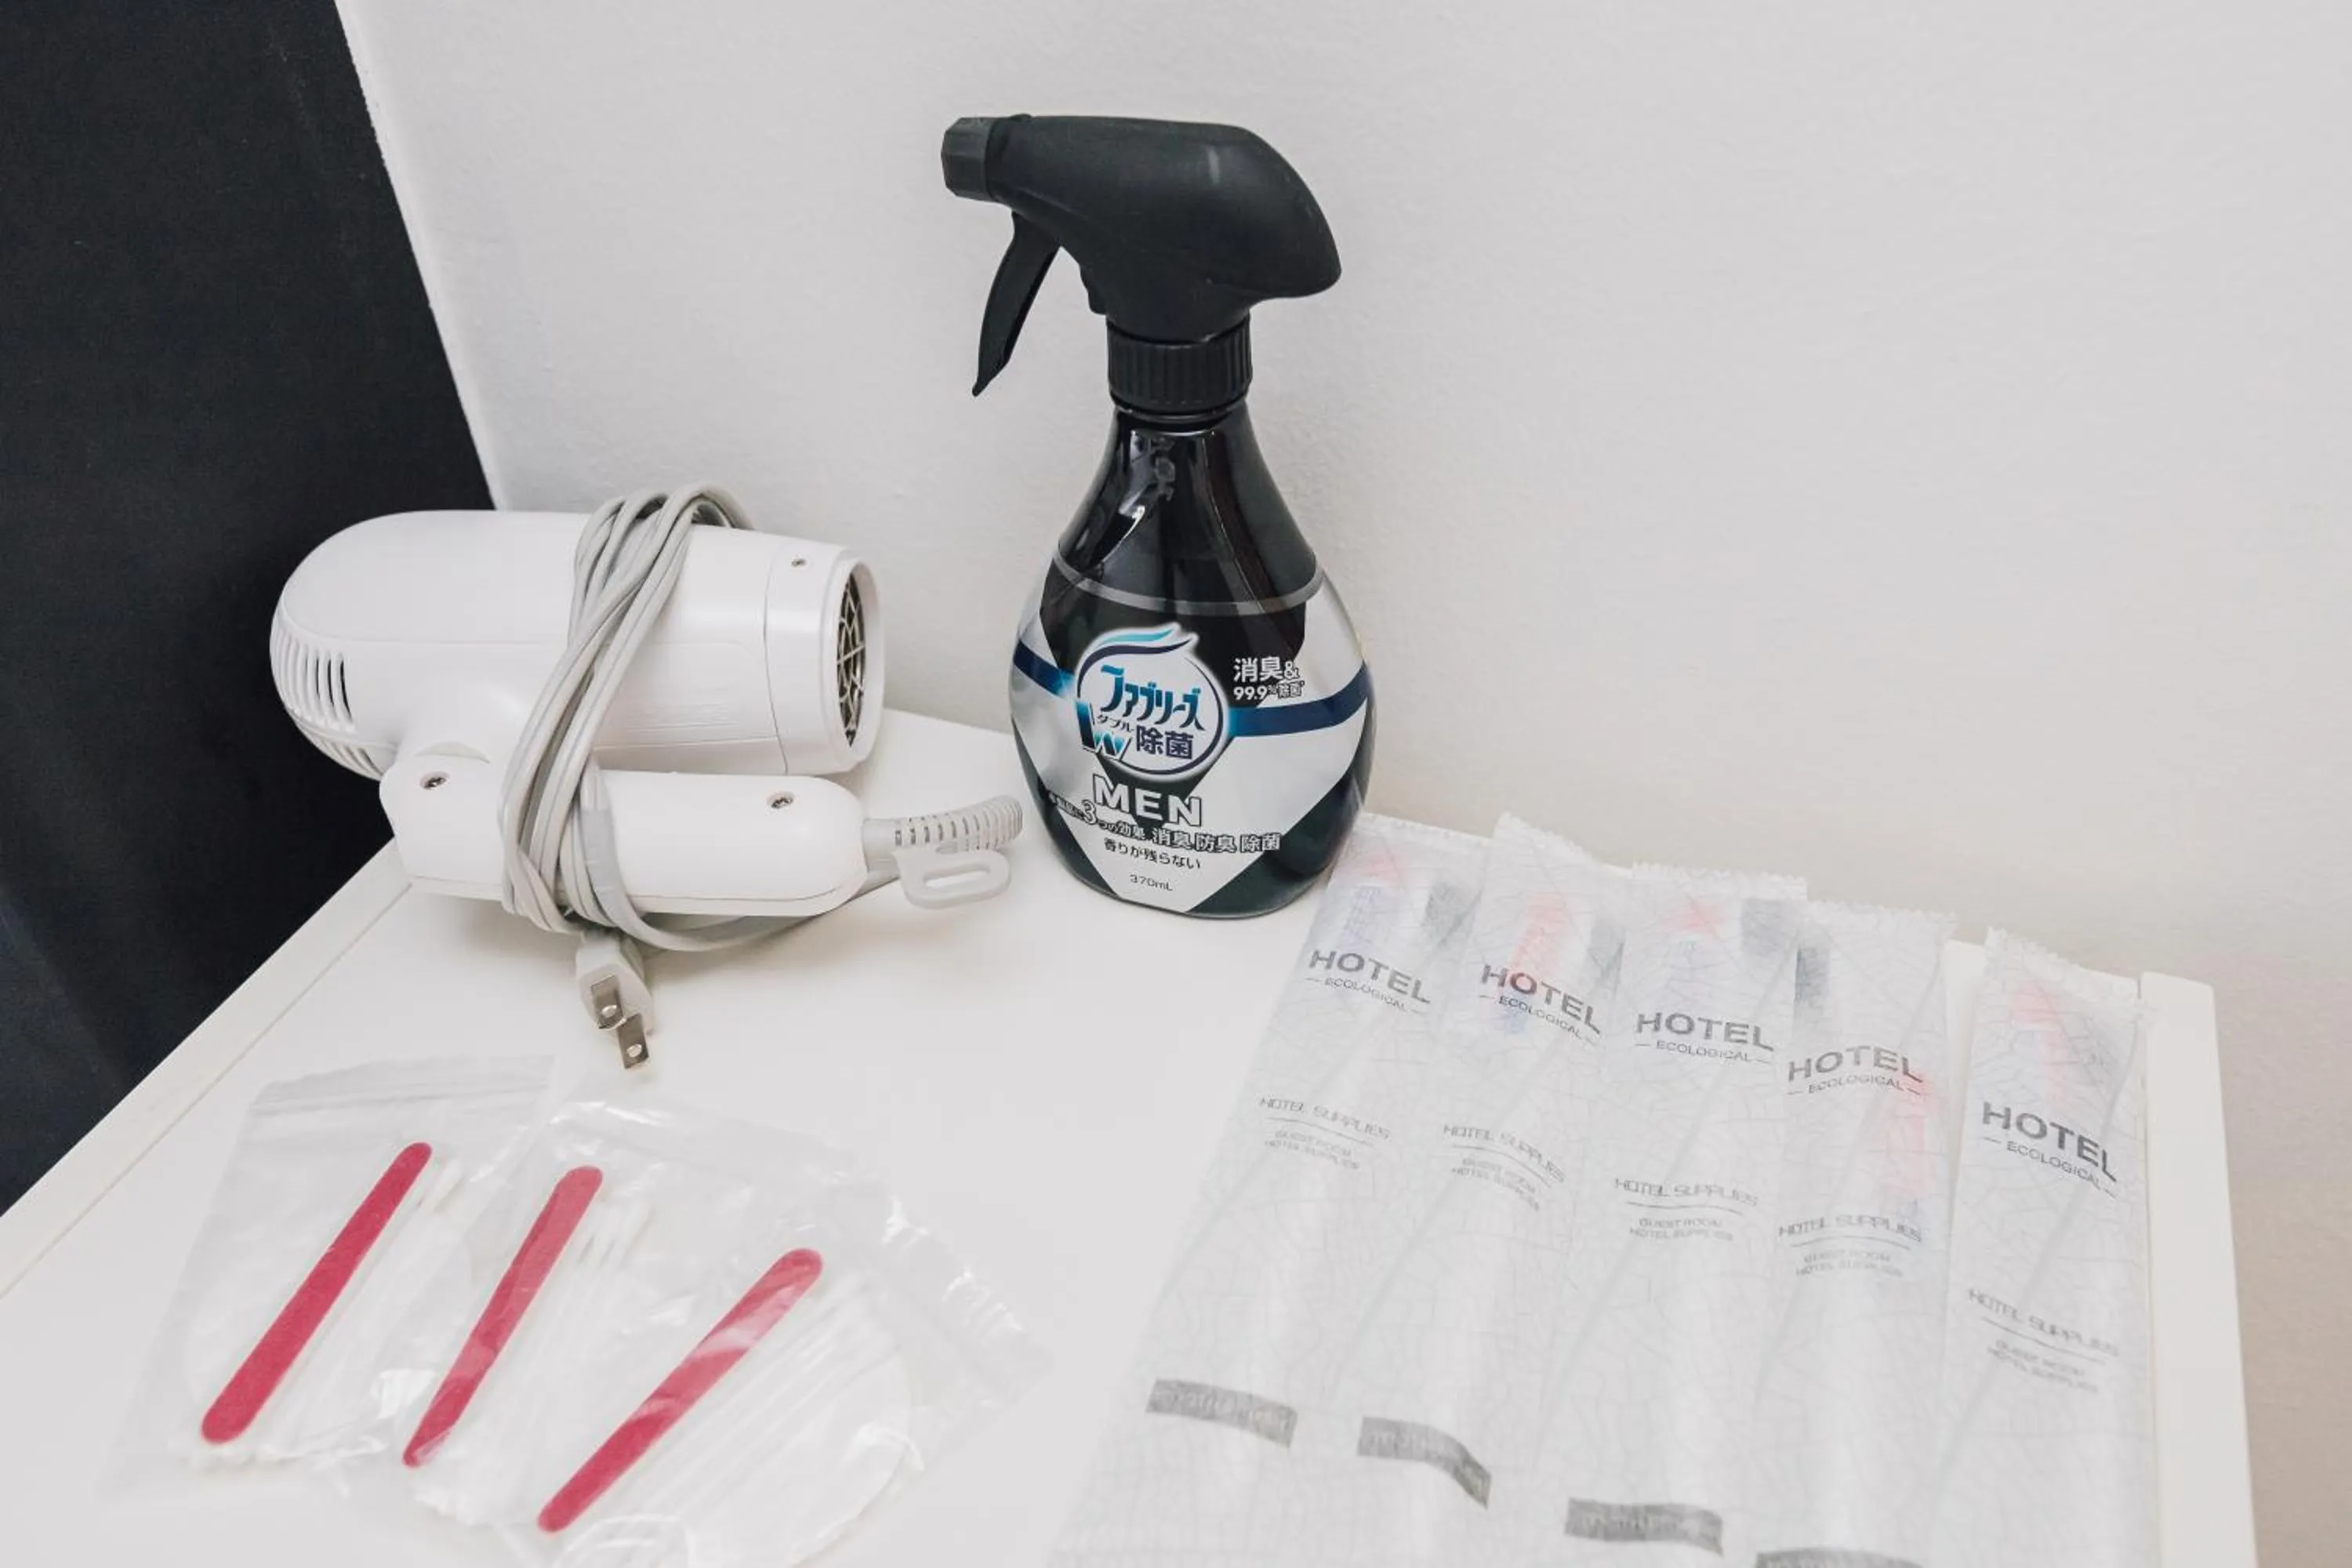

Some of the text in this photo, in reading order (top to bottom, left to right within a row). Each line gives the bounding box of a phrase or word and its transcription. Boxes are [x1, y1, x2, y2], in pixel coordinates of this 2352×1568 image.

[1233, 655, 1300, 682] 消臭&
[1101, 664, 1205, 731] ファブリーズ
[1098, 714, 1134, 733] ダブル
[1093, 773, 1202, 826] MEN
[1104, 837, 1201, 869] 香りが残らない
[1129, 873, 1174, 891] 370mL
[1308, 948, 1431, 1004] HOTEL
[1324, 976, 1406, 1013] ECOLOGICAL
[1481, 964, 1601, 1035] HOTEL
[1499, 994, 1582, 1040] ECOLOGICAL
[1636, 1011, 1773, 1051] HOTEL
[1656, 1040, 1751, 1063] ECOLOGICAL
[1788, 1045, 1922, 1083] HOTEL
[1809, 1075, 1904, 1094] ECOLOGICAL
[1982, 1101, 2117, 1183] HOTEL
[2006, 1140, 2101, 1190] ECOLOGICAL
[1615, 1178, 1669, 1196] HOTEL
[1968, 1288, 2025, 1324] HOTEL
